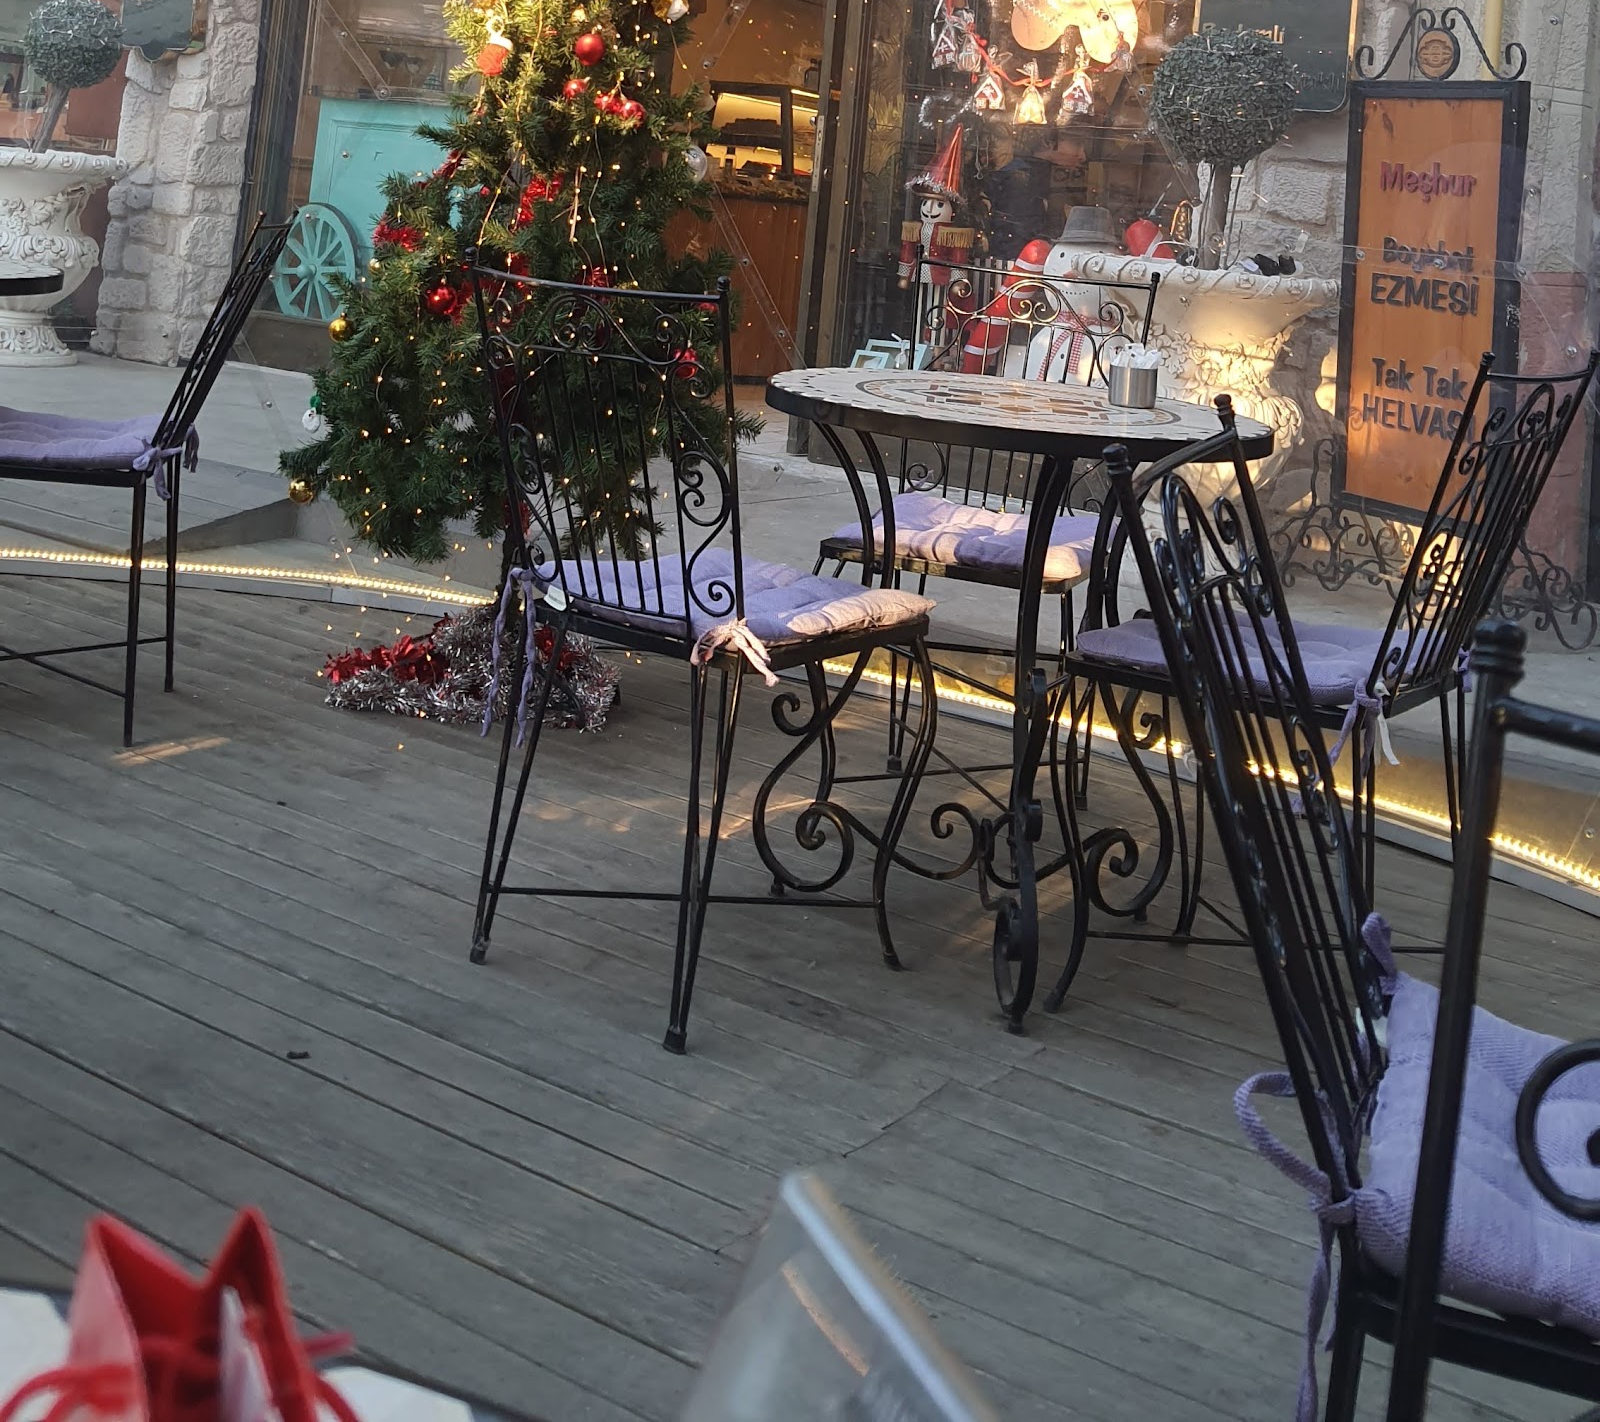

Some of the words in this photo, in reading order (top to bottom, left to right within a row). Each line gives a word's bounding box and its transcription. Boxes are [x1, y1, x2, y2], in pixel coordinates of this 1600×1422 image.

[1380, 160, 1478, 203] Meşhur
[1371, 272, 1480, 317] EZMESİ
[1372, 357, 1415, 393] Tak
[1423, 365, 1468, 402] Tak
